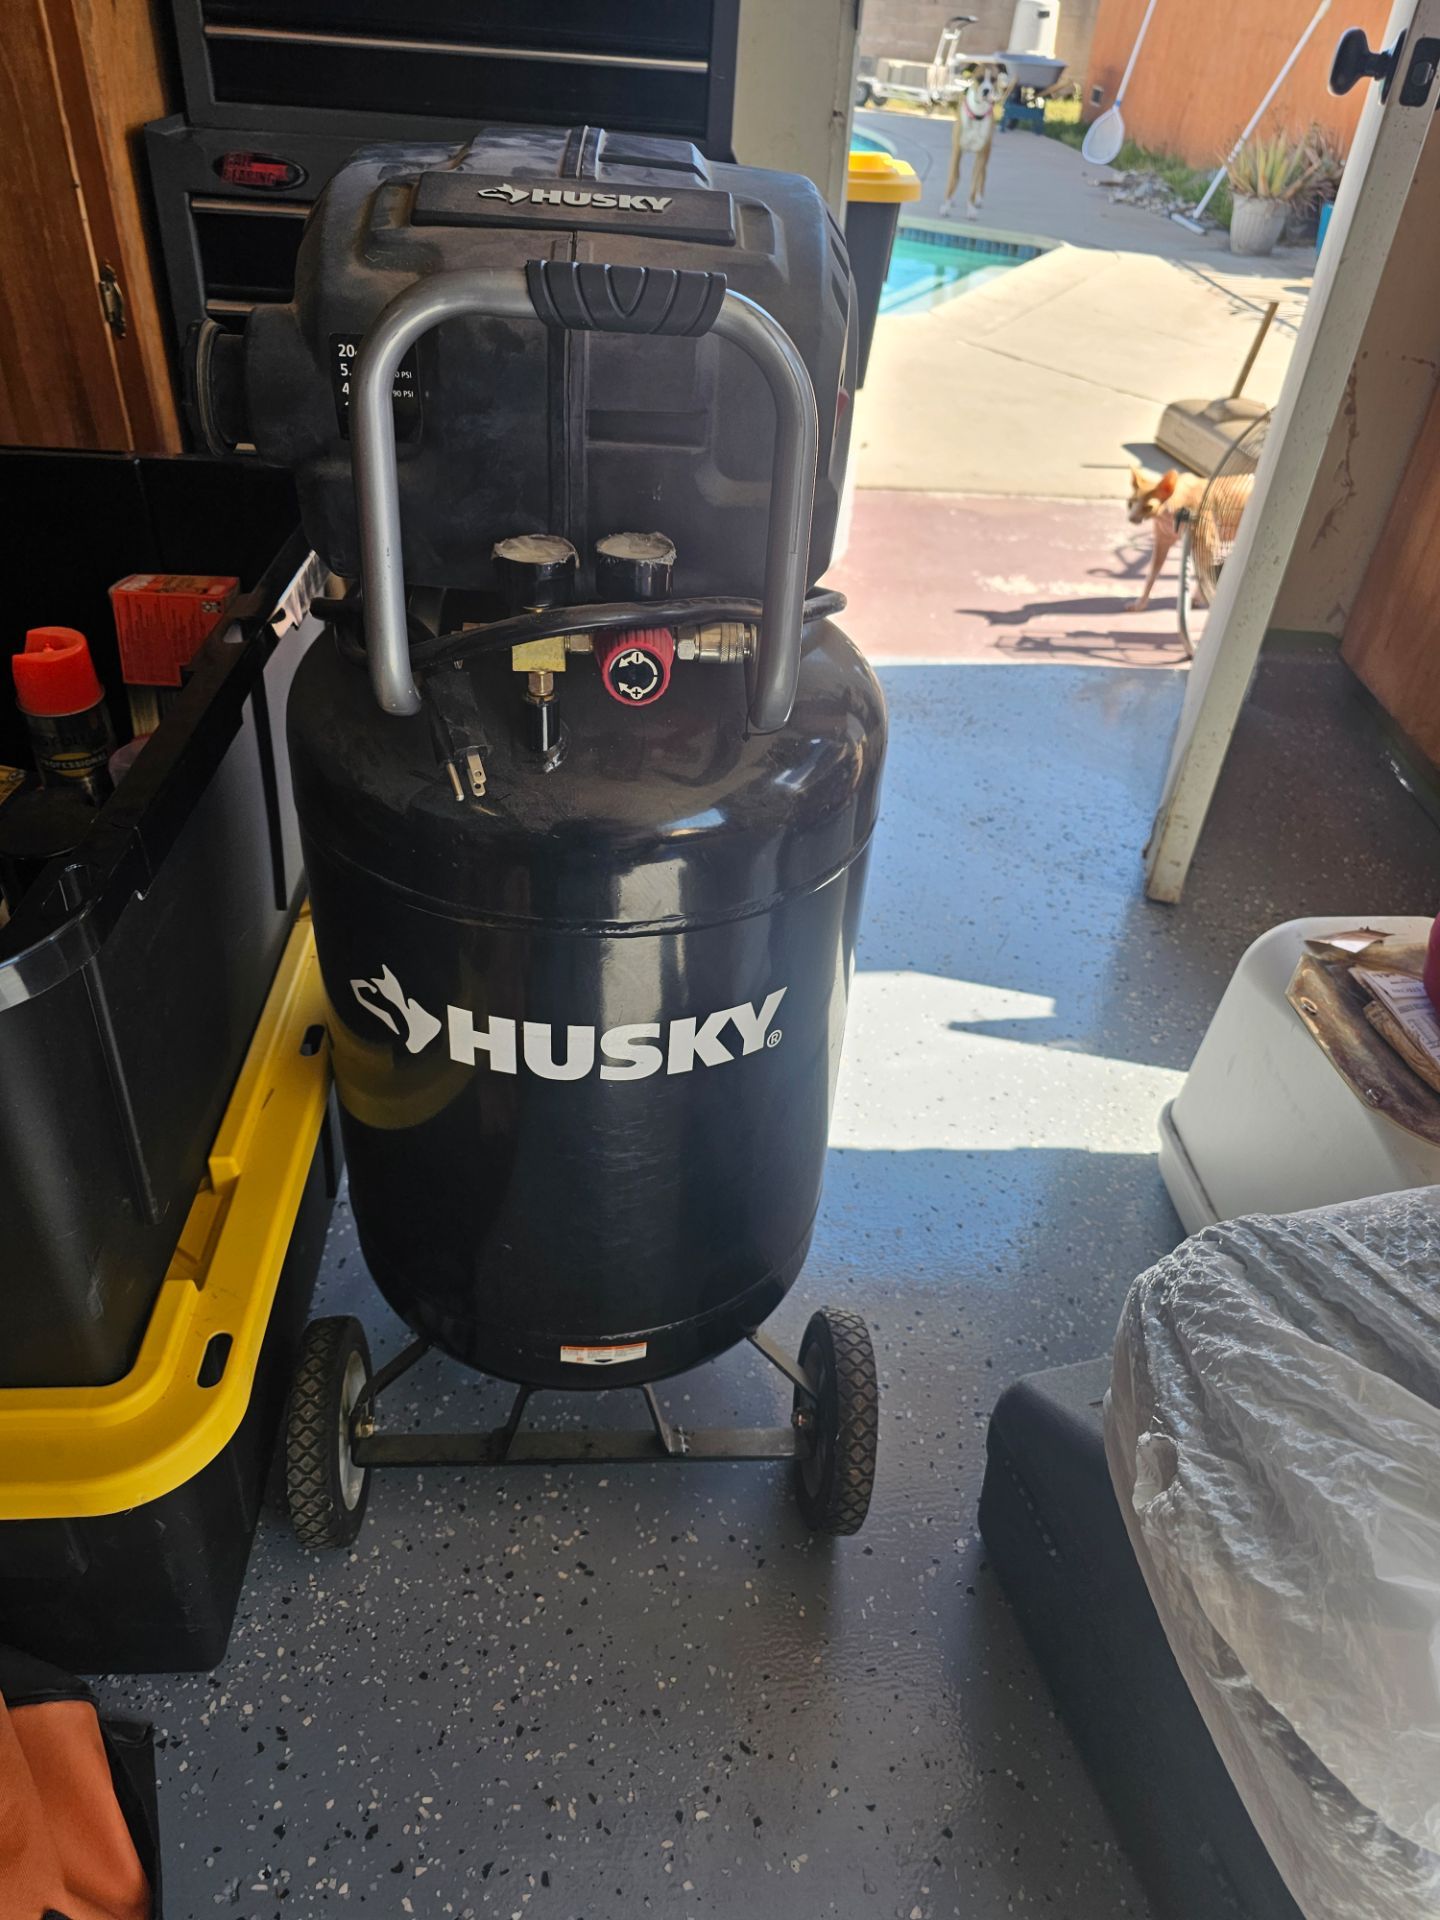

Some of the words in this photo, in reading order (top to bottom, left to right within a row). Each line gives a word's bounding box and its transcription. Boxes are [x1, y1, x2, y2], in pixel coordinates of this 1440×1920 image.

[531, 189, 672, 212] HUSKY
[337, 343, 358, 358] 20
[340, 363, 352, 377] 5.
[401, 371, 412, 379] PSI
[392, 390, 402, 398] 90
[403, 390, 414, 398] PSI
